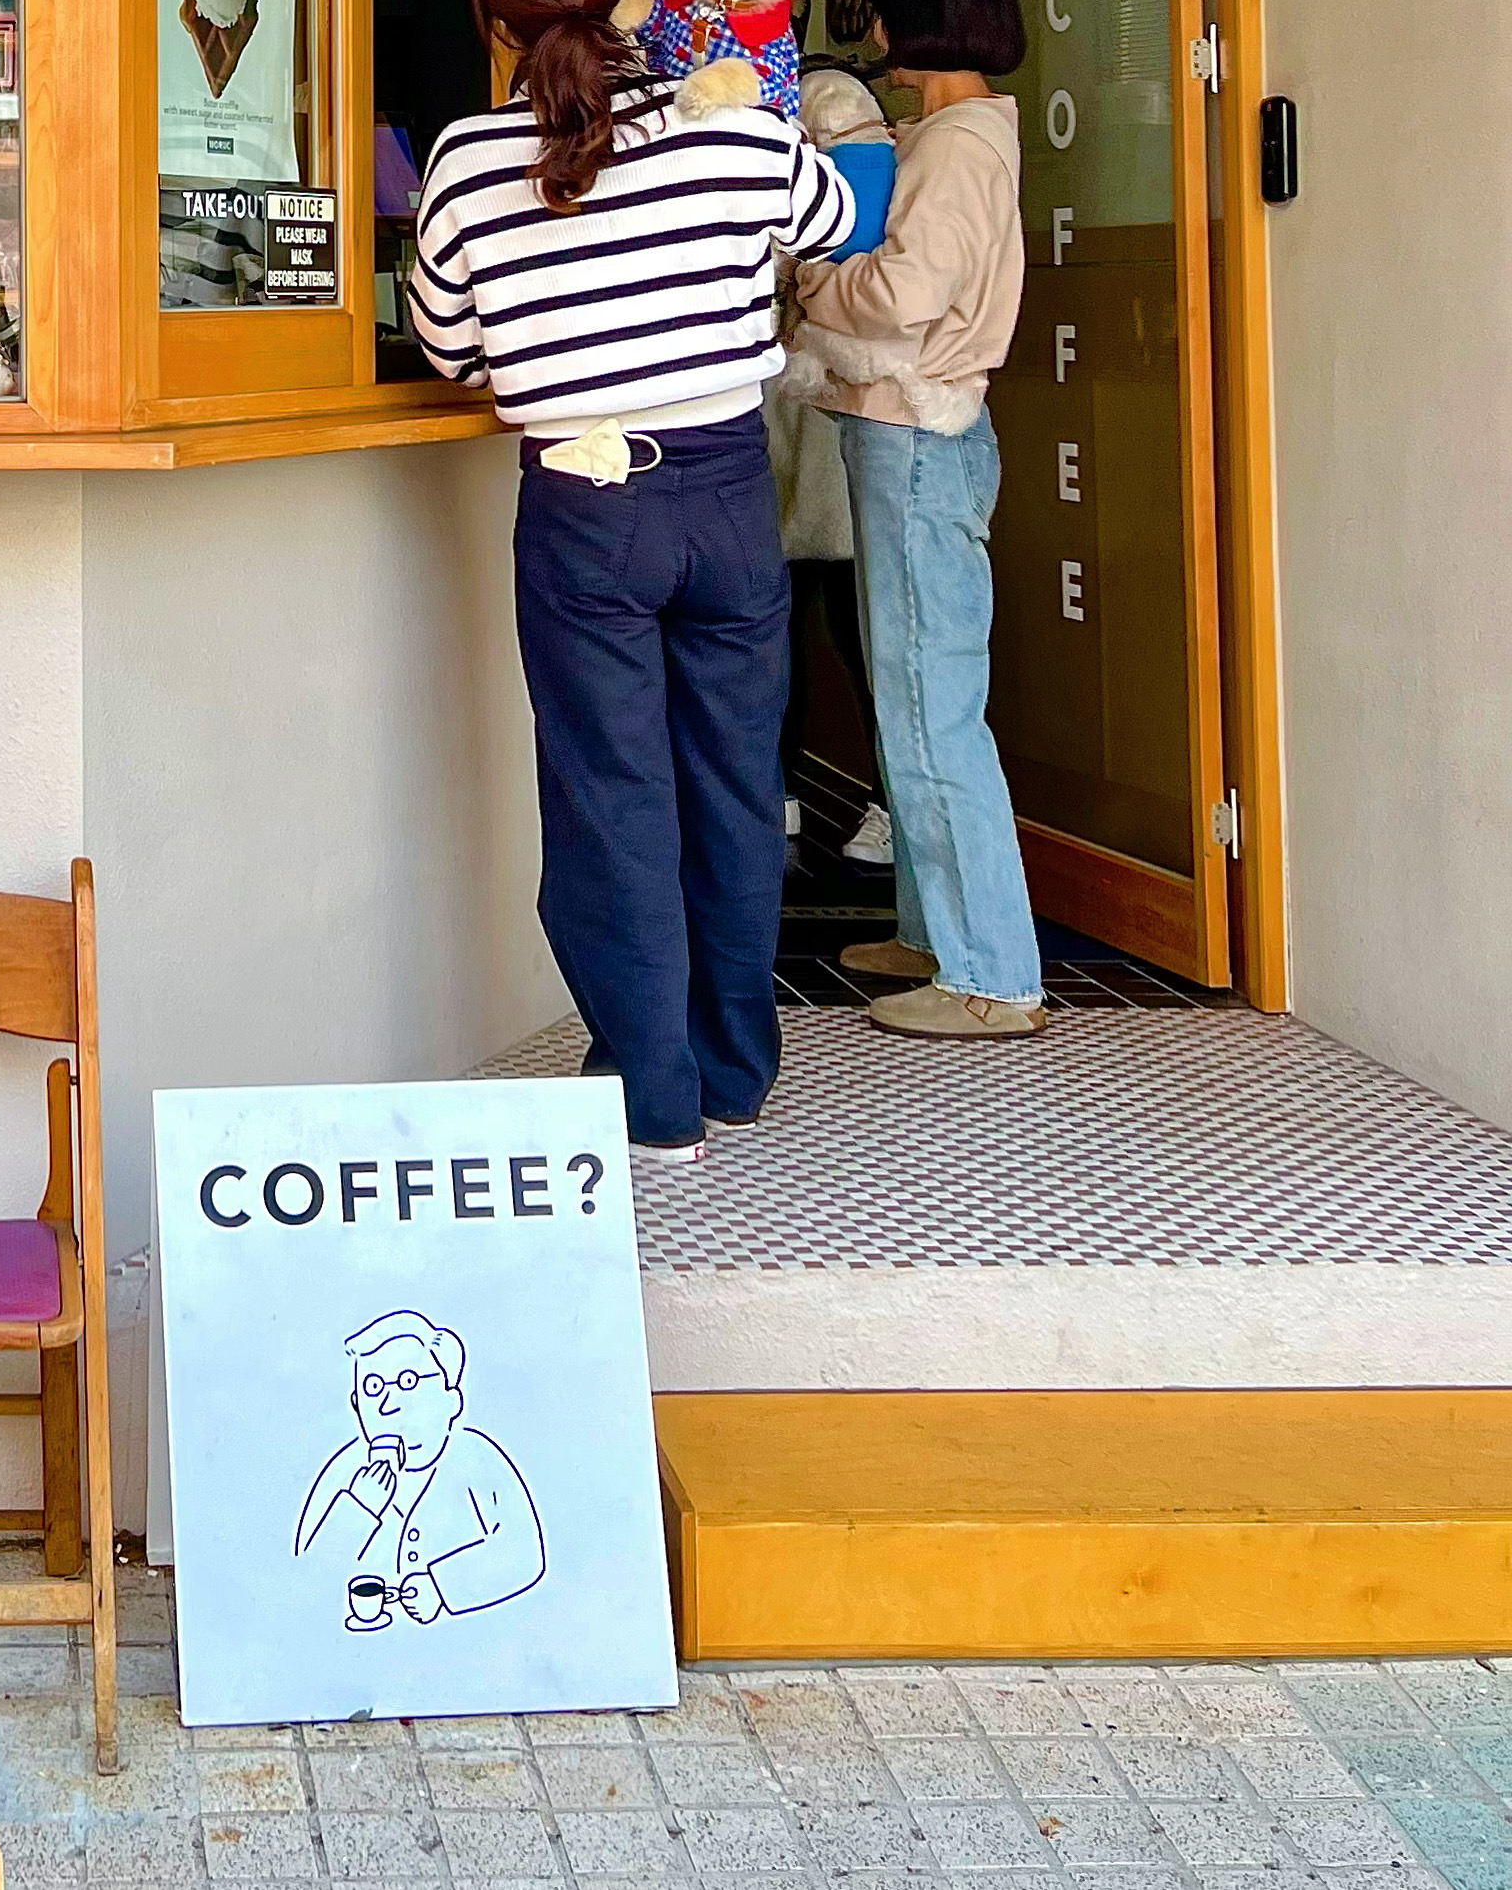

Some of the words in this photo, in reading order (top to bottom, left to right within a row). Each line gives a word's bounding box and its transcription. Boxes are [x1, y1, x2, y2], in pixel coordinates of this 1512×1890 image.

[279, 197, 323, 219] NOTICE
[276, 226, 304, 243] PLEASE
[305, 228, 327, 244] WEAR
[290, 248, 313, 265] MASK
[268, 270, 297, 287] BEFORE
[298, 271, 334, 287] ENTERING
[199, 1152, 604, 1228] COFFEE?
